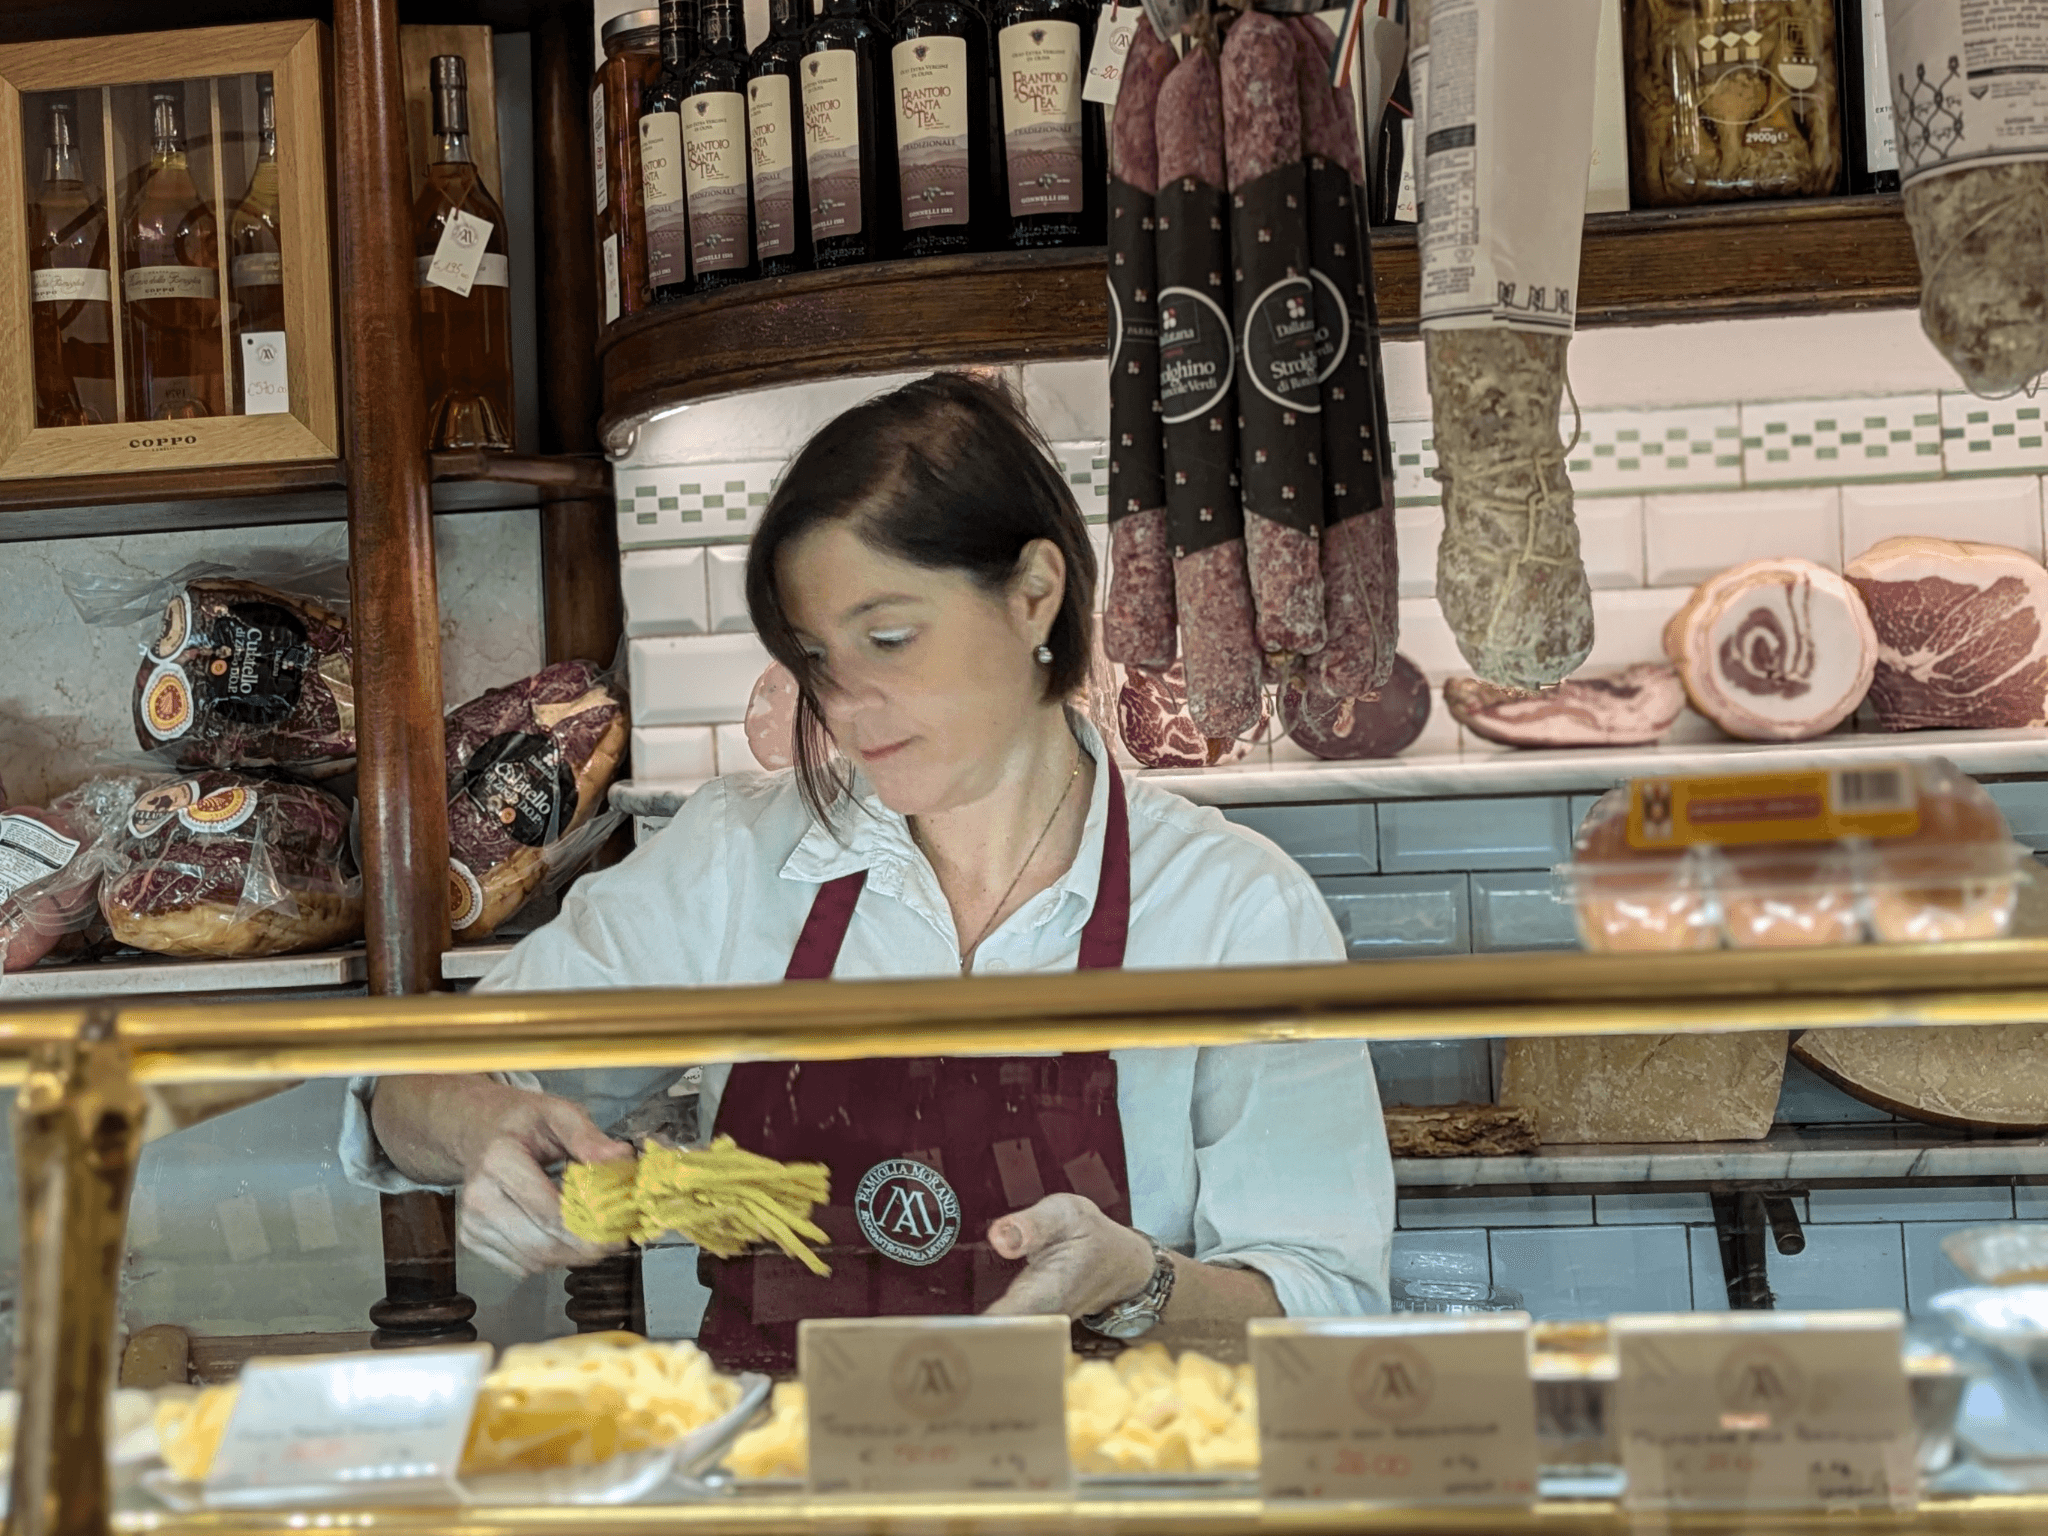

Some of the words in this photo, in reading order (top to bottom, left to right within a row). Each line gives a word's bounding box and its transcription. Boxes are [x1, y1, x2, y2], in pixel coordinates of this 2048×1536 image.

[1012, 71, 1068, 93] FRANTOIO
[901, 86, 951, 109] FRANTOIO
[1018, 83, 1058, 103] SANTA
[904, 99, 941, 119] SANTA
[1014, 126, 1072, 136] TRADIZIONALE
[1746, 132, 1777, 144] 2900g
[687, 139, 730, 160] FRANTOIO
[903, 139, 955, 151] TRADIZIONALE
[689, 152, 721, 171] SANTA
[909, 208, 940, 218] GONNELLI
[129, 436, 197, 448] COPPO
[240, 627, 263, 694] Culatello
[494, 762, 551, 815] Culatello
[859, 1163, 908, 1202] FAMIGLIA
[909, 1165, 960, 1218] MORANDI
